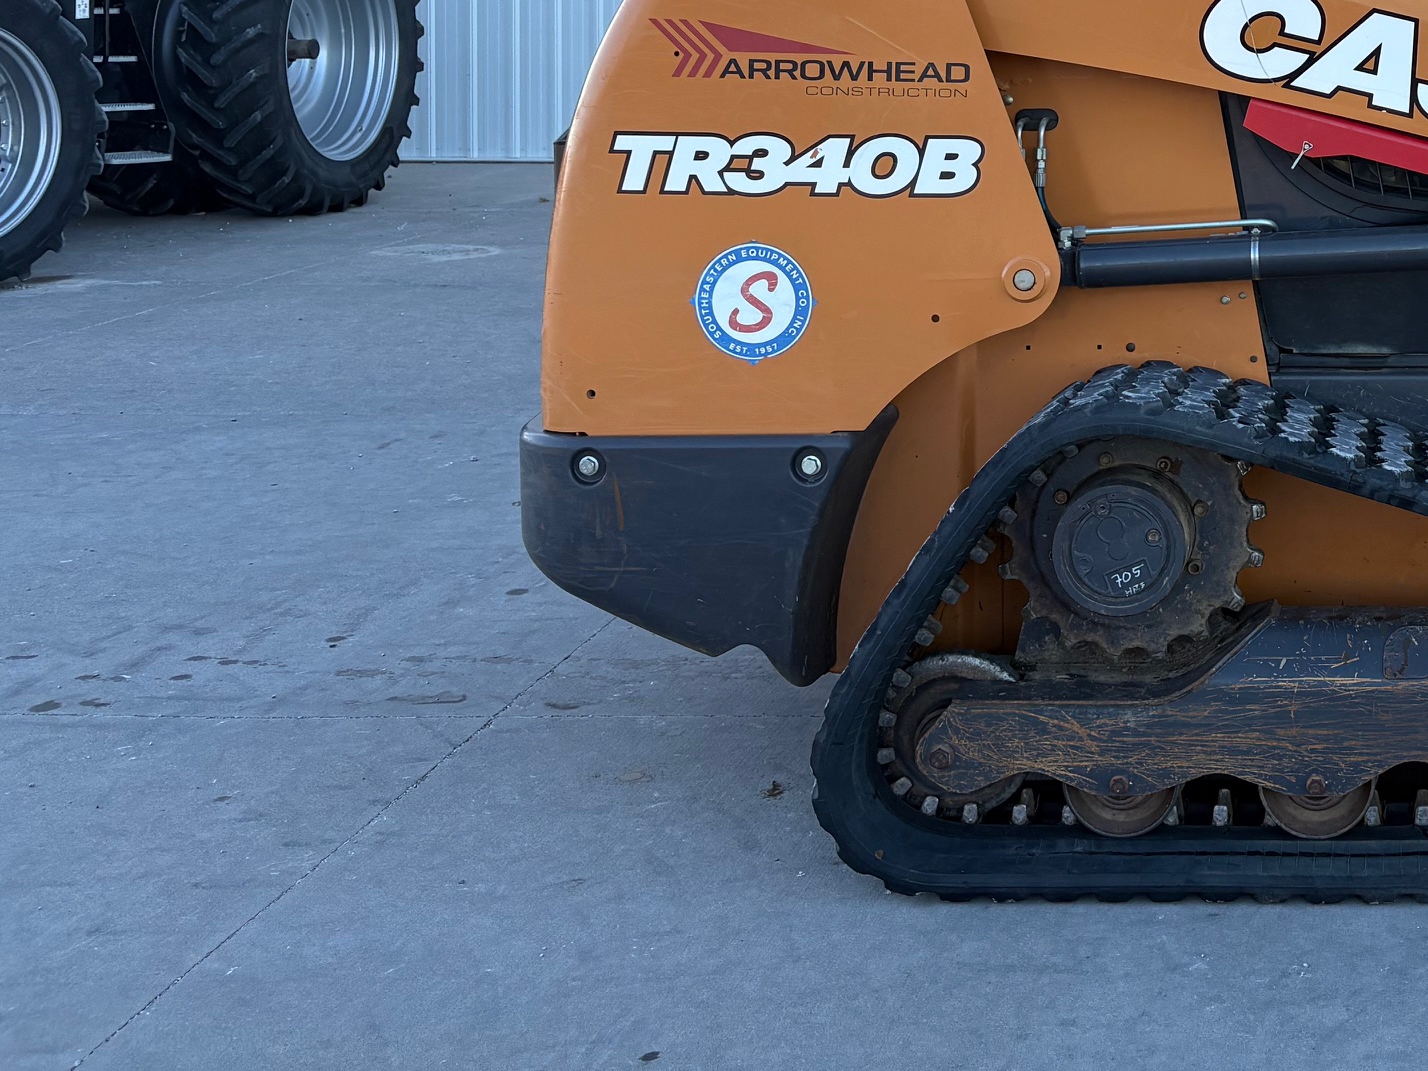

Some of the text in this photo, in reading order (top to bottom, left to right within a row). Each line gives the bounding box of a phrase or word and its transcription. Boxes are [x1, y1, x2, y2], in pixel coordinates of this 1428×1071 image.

[719, 57, 971, 84] ARROWHEAD
[804, 85, 969, 99] CONSTRUCTION
[608, 130, 986, 199] TR340B
[701, 248, 807, 339] SOUTHEASTERN EQUIPMENT CO. INC.
[728, 270, 779, 334] S
[728, 342, 778, 355] EST. 1957
[1110, 563, 1145, 588] 705
